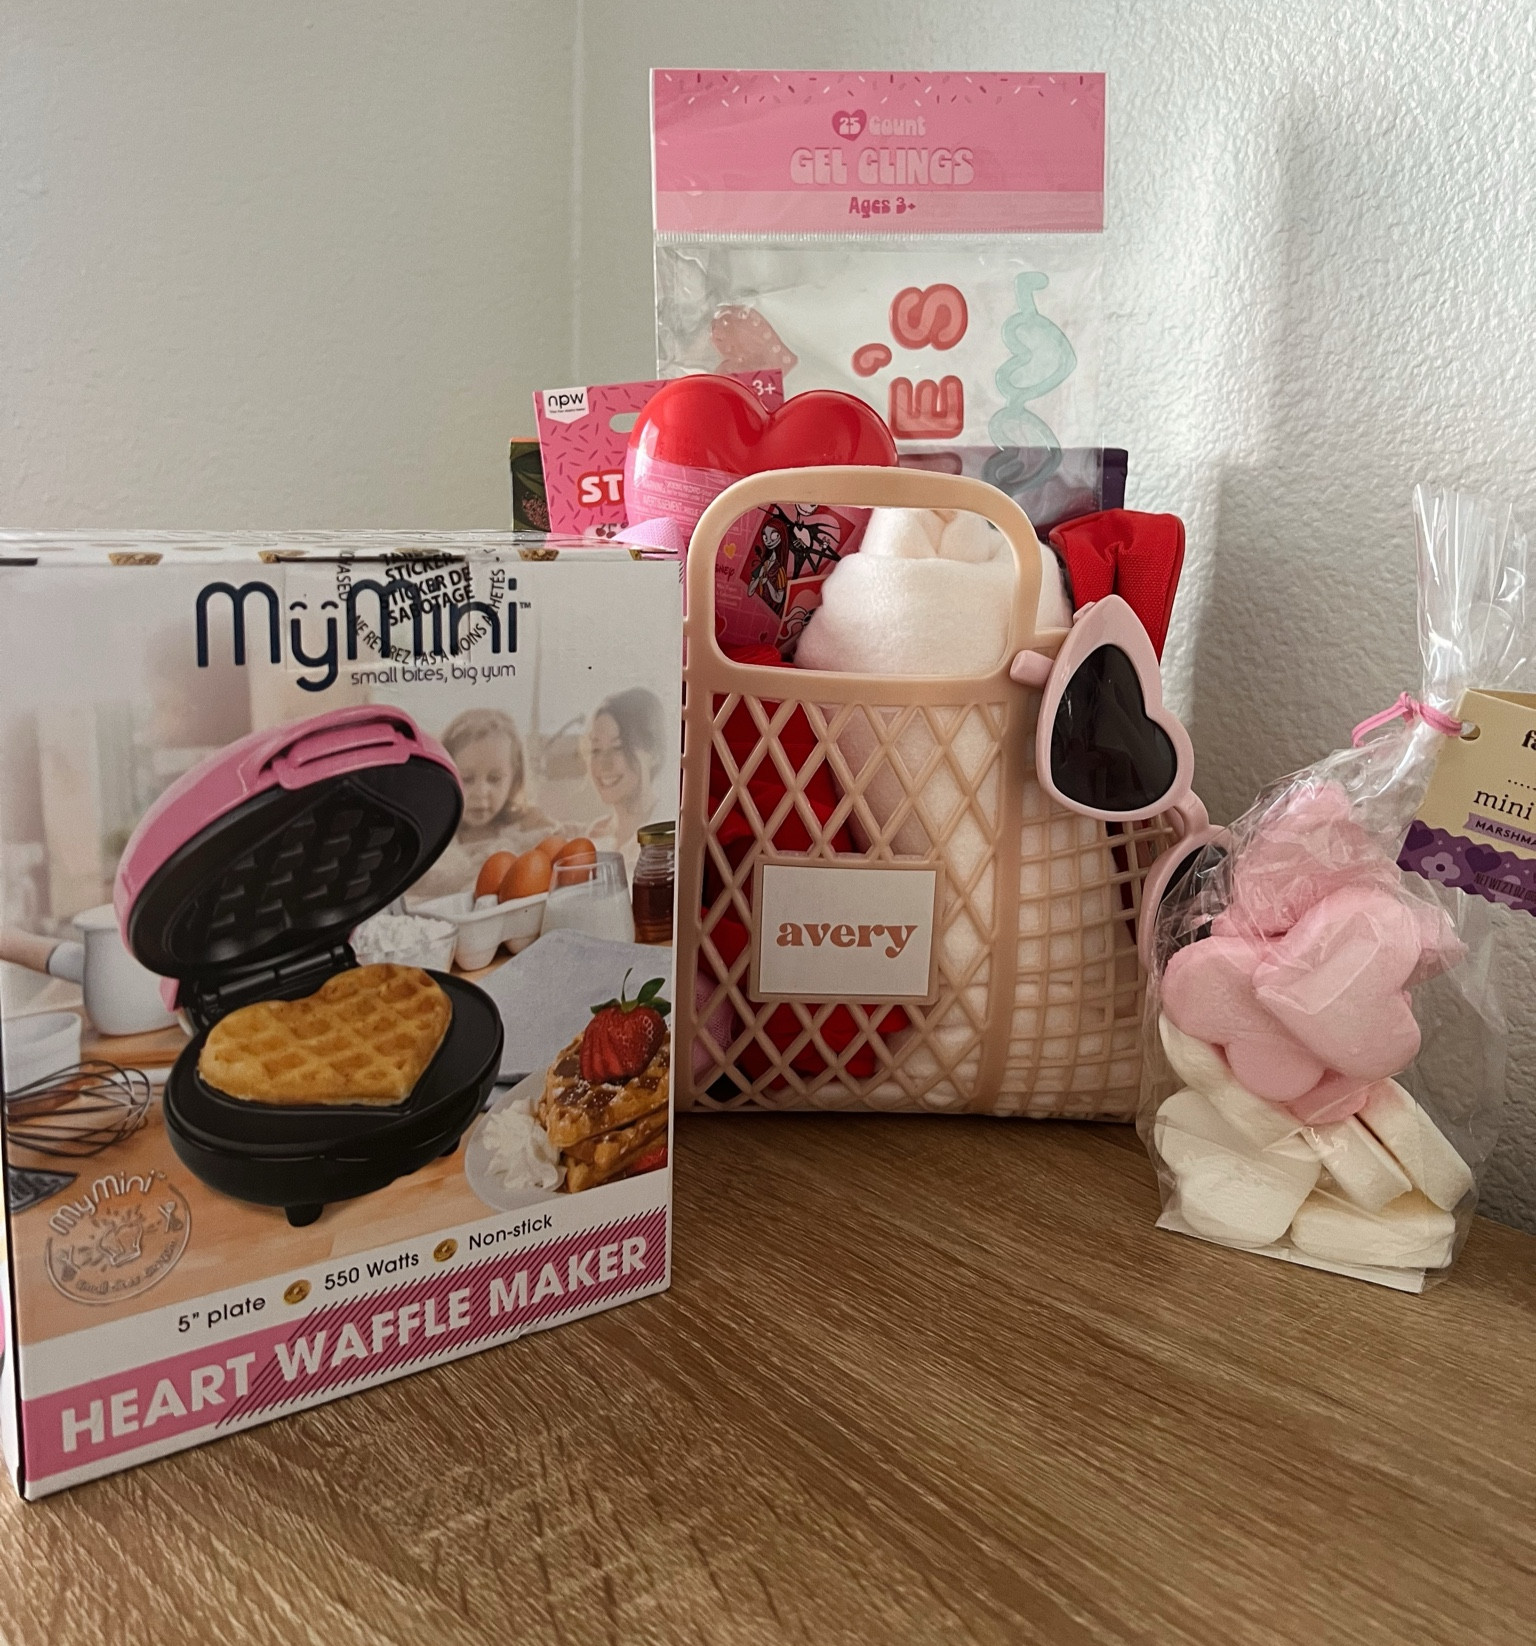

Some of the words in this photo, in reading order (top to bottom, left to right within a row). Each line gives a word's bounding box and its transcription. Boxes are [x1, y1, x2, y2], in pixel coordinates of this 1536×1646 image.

[838, 116, 862, 135] 25
[868, 115, 927, 137] Count
[789, 146, 849, 186] GEL
[857, 146, 976, 186] CLINGS
[848, 196, 891, 219] Ages
[895, 196, 917, 215] 3+
[547, 392, 585, 409] npw
[751, 378, 777, 396] 3+
[362, 628, 412, 666] REREZ
[351, 666, 398, 686] small
[402, 666, 448, 684] bites,
[451, 663, 478, 686] big
[481, 663, 516, 683] yum
[1472, 790, 1535, 821] mini
[776, 922, 919, 959] avery
[207, 1295, 267, 1329] plate
[324, 1266, 361, 1291] 550
[366, 1251, 421, 1279] Watts
[468, 1213, 554, 1251] Non-stick
[59, 1353, 257, 1456] HEART
[273, 1284, 474, 1383] WAFFLE
[487, 1234, 649, 1321] MAKER
